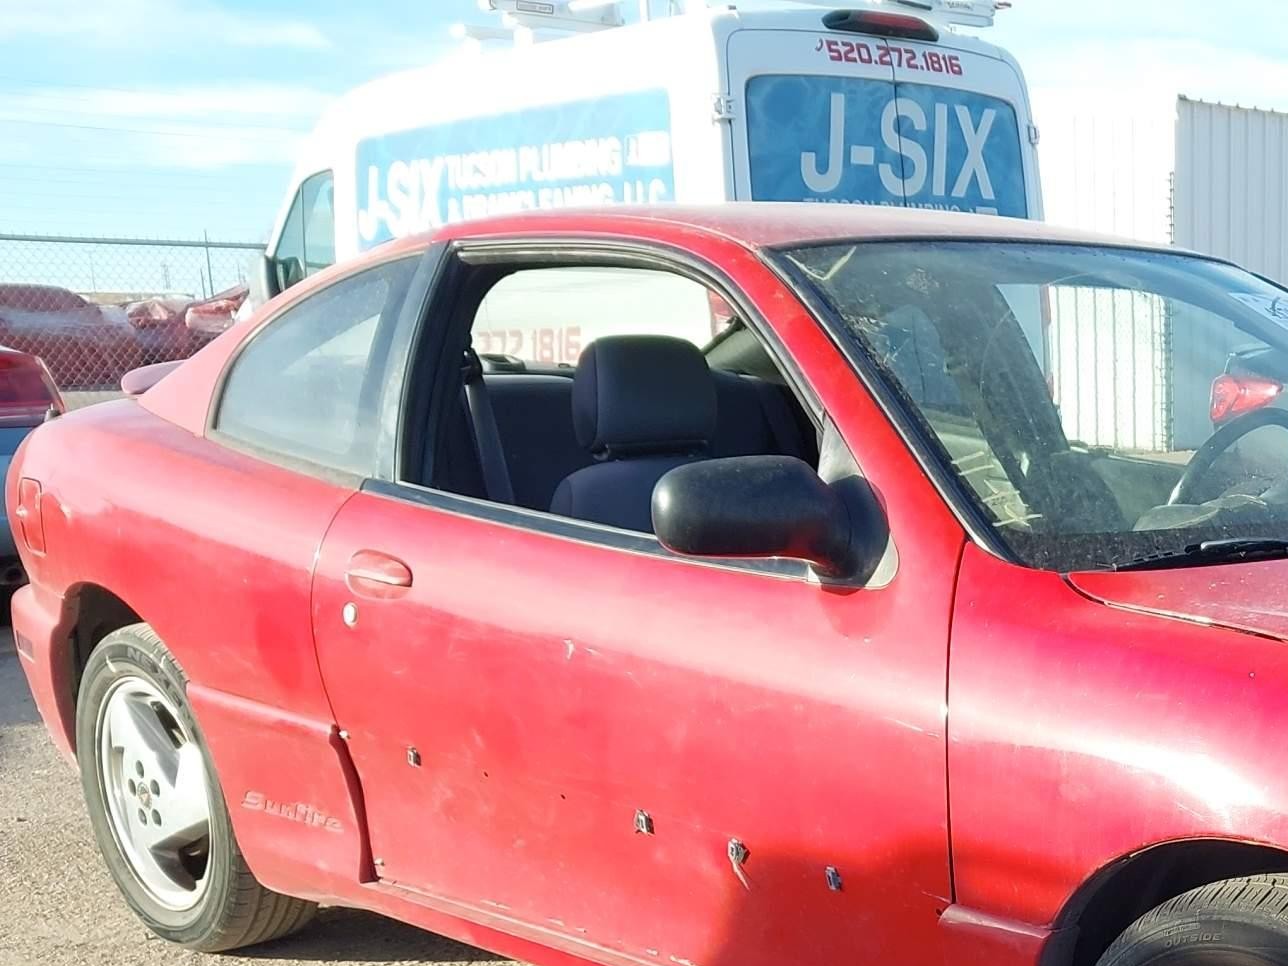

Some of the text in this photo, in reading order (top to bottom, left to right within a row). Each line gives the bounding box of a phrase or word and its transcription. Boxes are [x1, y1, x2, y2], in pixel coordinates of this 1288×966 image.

[825, 39, 963, 76] 520.272.1816
[800, 92, 997, 200] J-SIX
[358, 157, 450, 240] J-SIX
[241, 790, 344, 833] Sunfire
